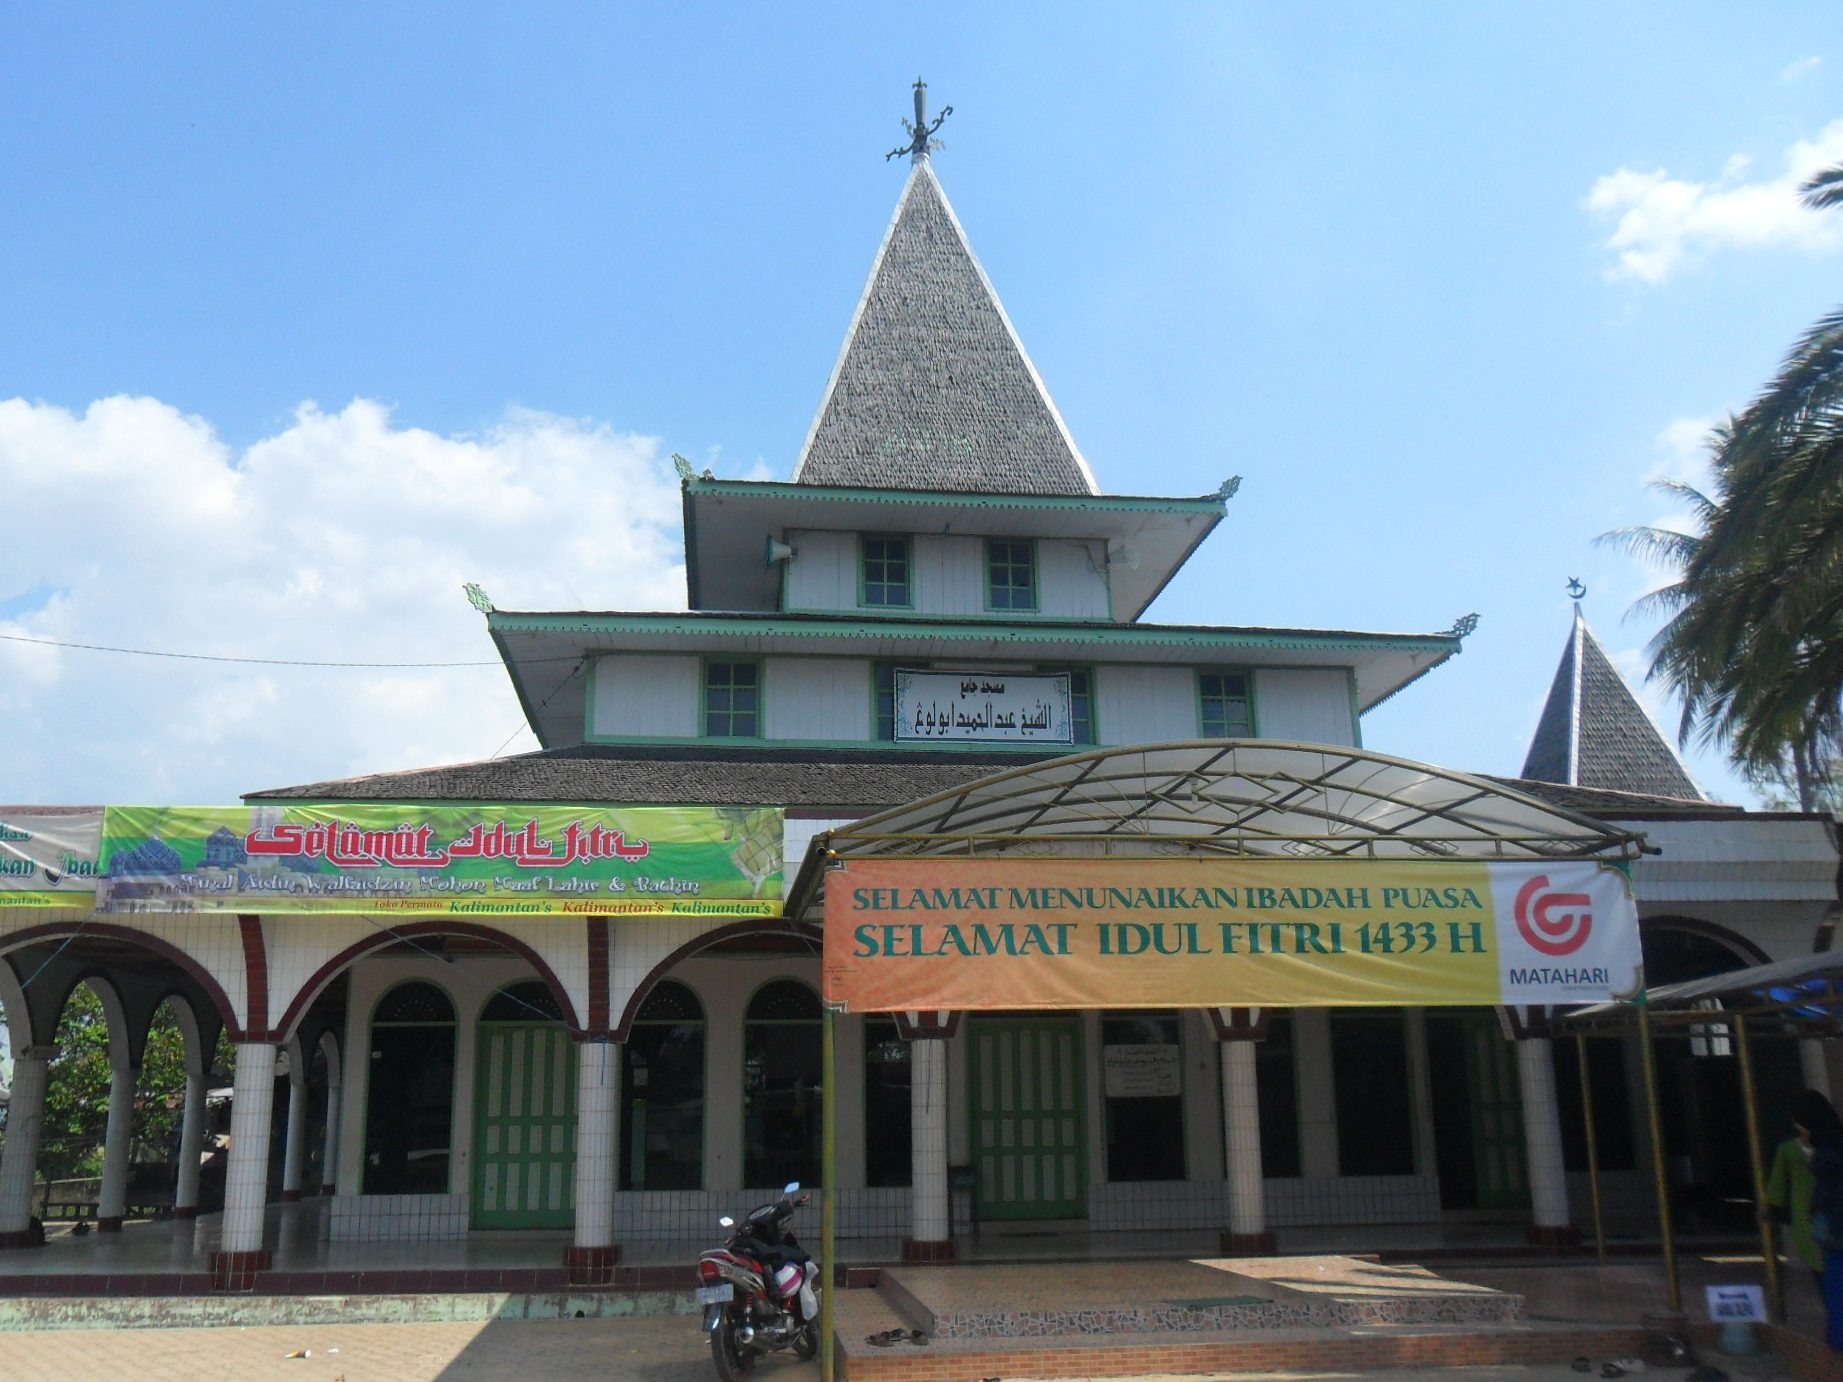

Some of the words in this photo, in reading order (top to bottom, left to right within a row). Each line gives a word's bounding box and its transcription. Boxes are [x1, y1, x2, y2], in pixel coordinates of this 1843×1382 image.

[960, 677, 978, 700] جامع
[980, 680, 1005, 697] مسجد
[1021, 698, 1052, 735] الشيخ
[246, 818, 450, 867] Selamat
[240, 873, 296, 893] Aidin
[418, 875, 486, 894] Mohon
[494, 875, 542, 891] Maaf
[545, 876, 599, 893] Lahir
[608, 876, 626, 891] &
[449, 901, 552, 913] Kalimantan's
[562, 901, 664, 913] Kalimantan's
[671, 902, 771, 914] Kalimantan's
[853, 887, 1003, 911] SELAMAT
[1008, 887, 1238, 910] MENUNAIKAN
[1244, 887, 1371, 909] IBADAH
[1381, 888, 1483, 909] PUASA
[853, 923, 1077, 958] SELAMAT
[1095, 922, 1212, 955] IDUL
[1217, 922, 1347, 954] FITRI
[1354, 921, 1437, 954] 1433
[1446, 922, 1487, 953] H
[1510, 968, 1609, 985] MATAHARI
